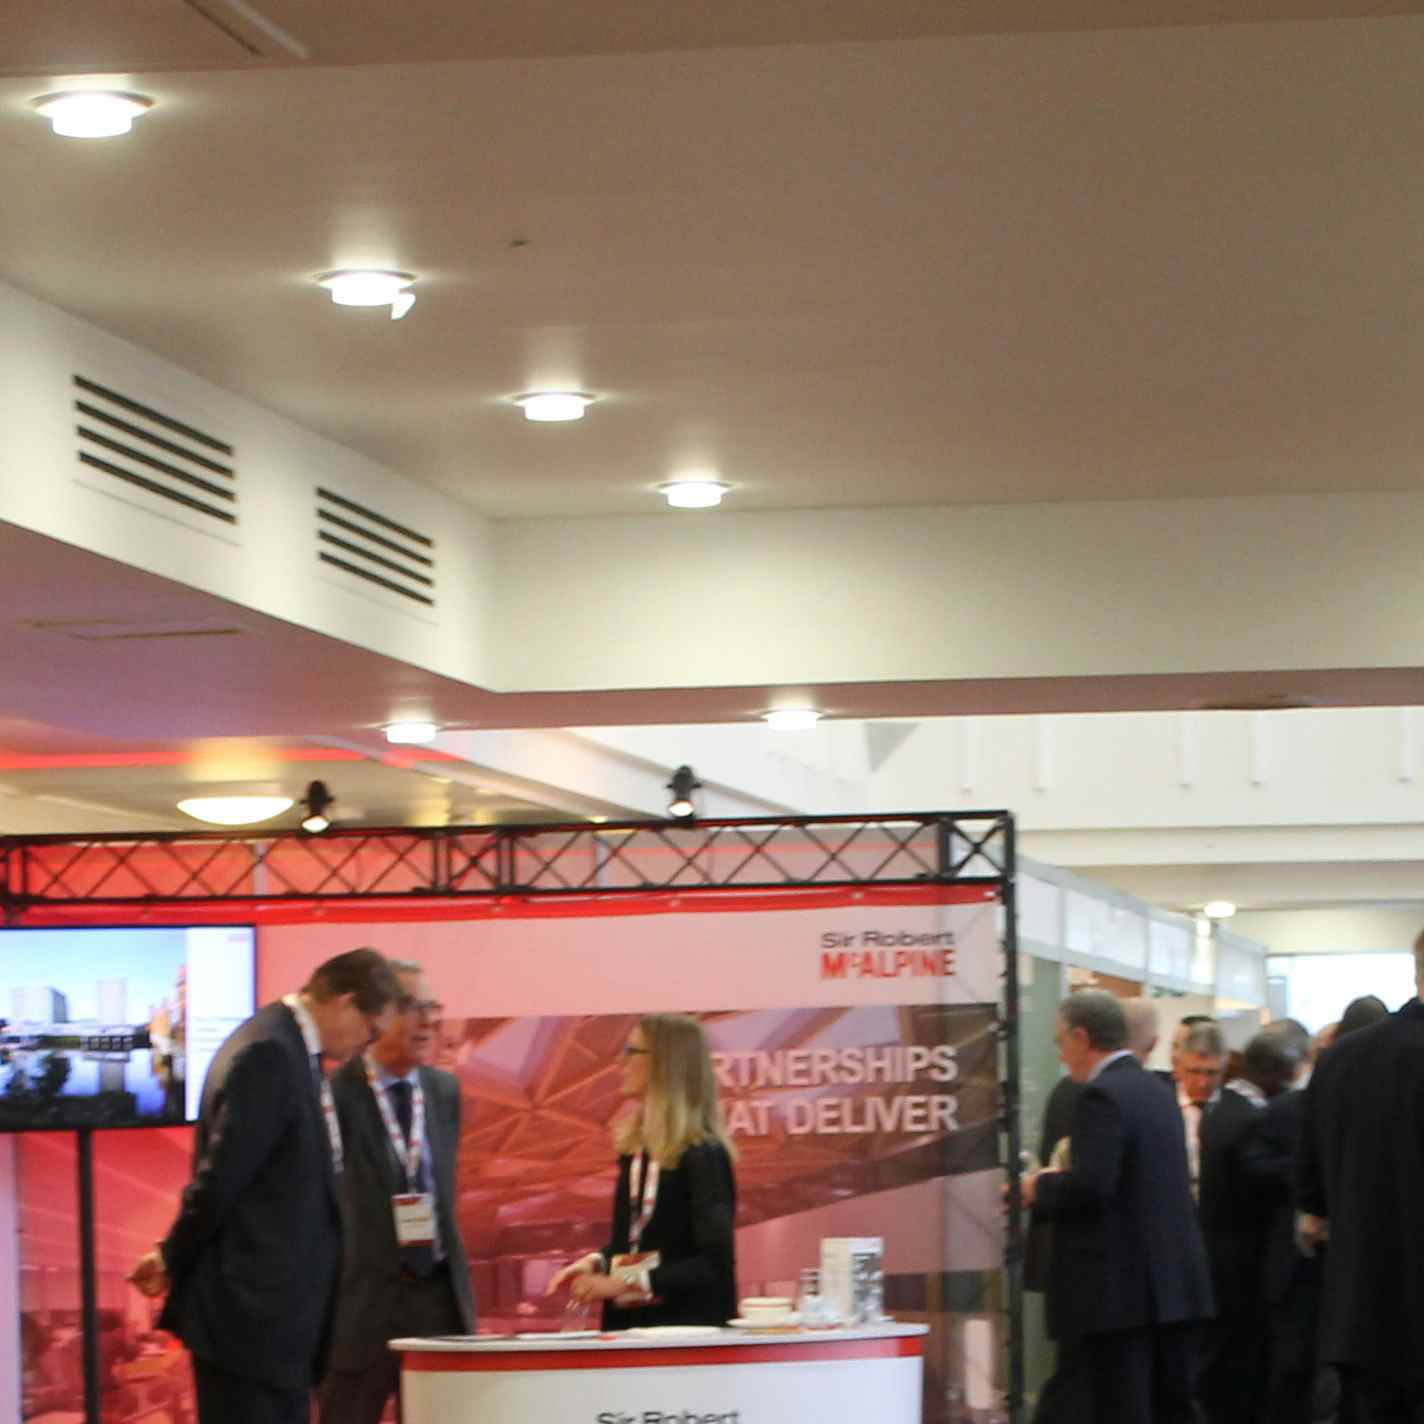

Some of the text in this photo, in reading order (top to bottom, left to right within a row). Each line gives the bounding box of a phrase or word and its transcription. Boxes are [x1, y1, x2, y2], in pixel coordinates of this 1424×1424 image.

[821, 930, 955, 948] Sir Robert
[712, 1046, 958, 1087] RTNERSHIPS
[728, 1094, 959, 1136] AT DELIVER
